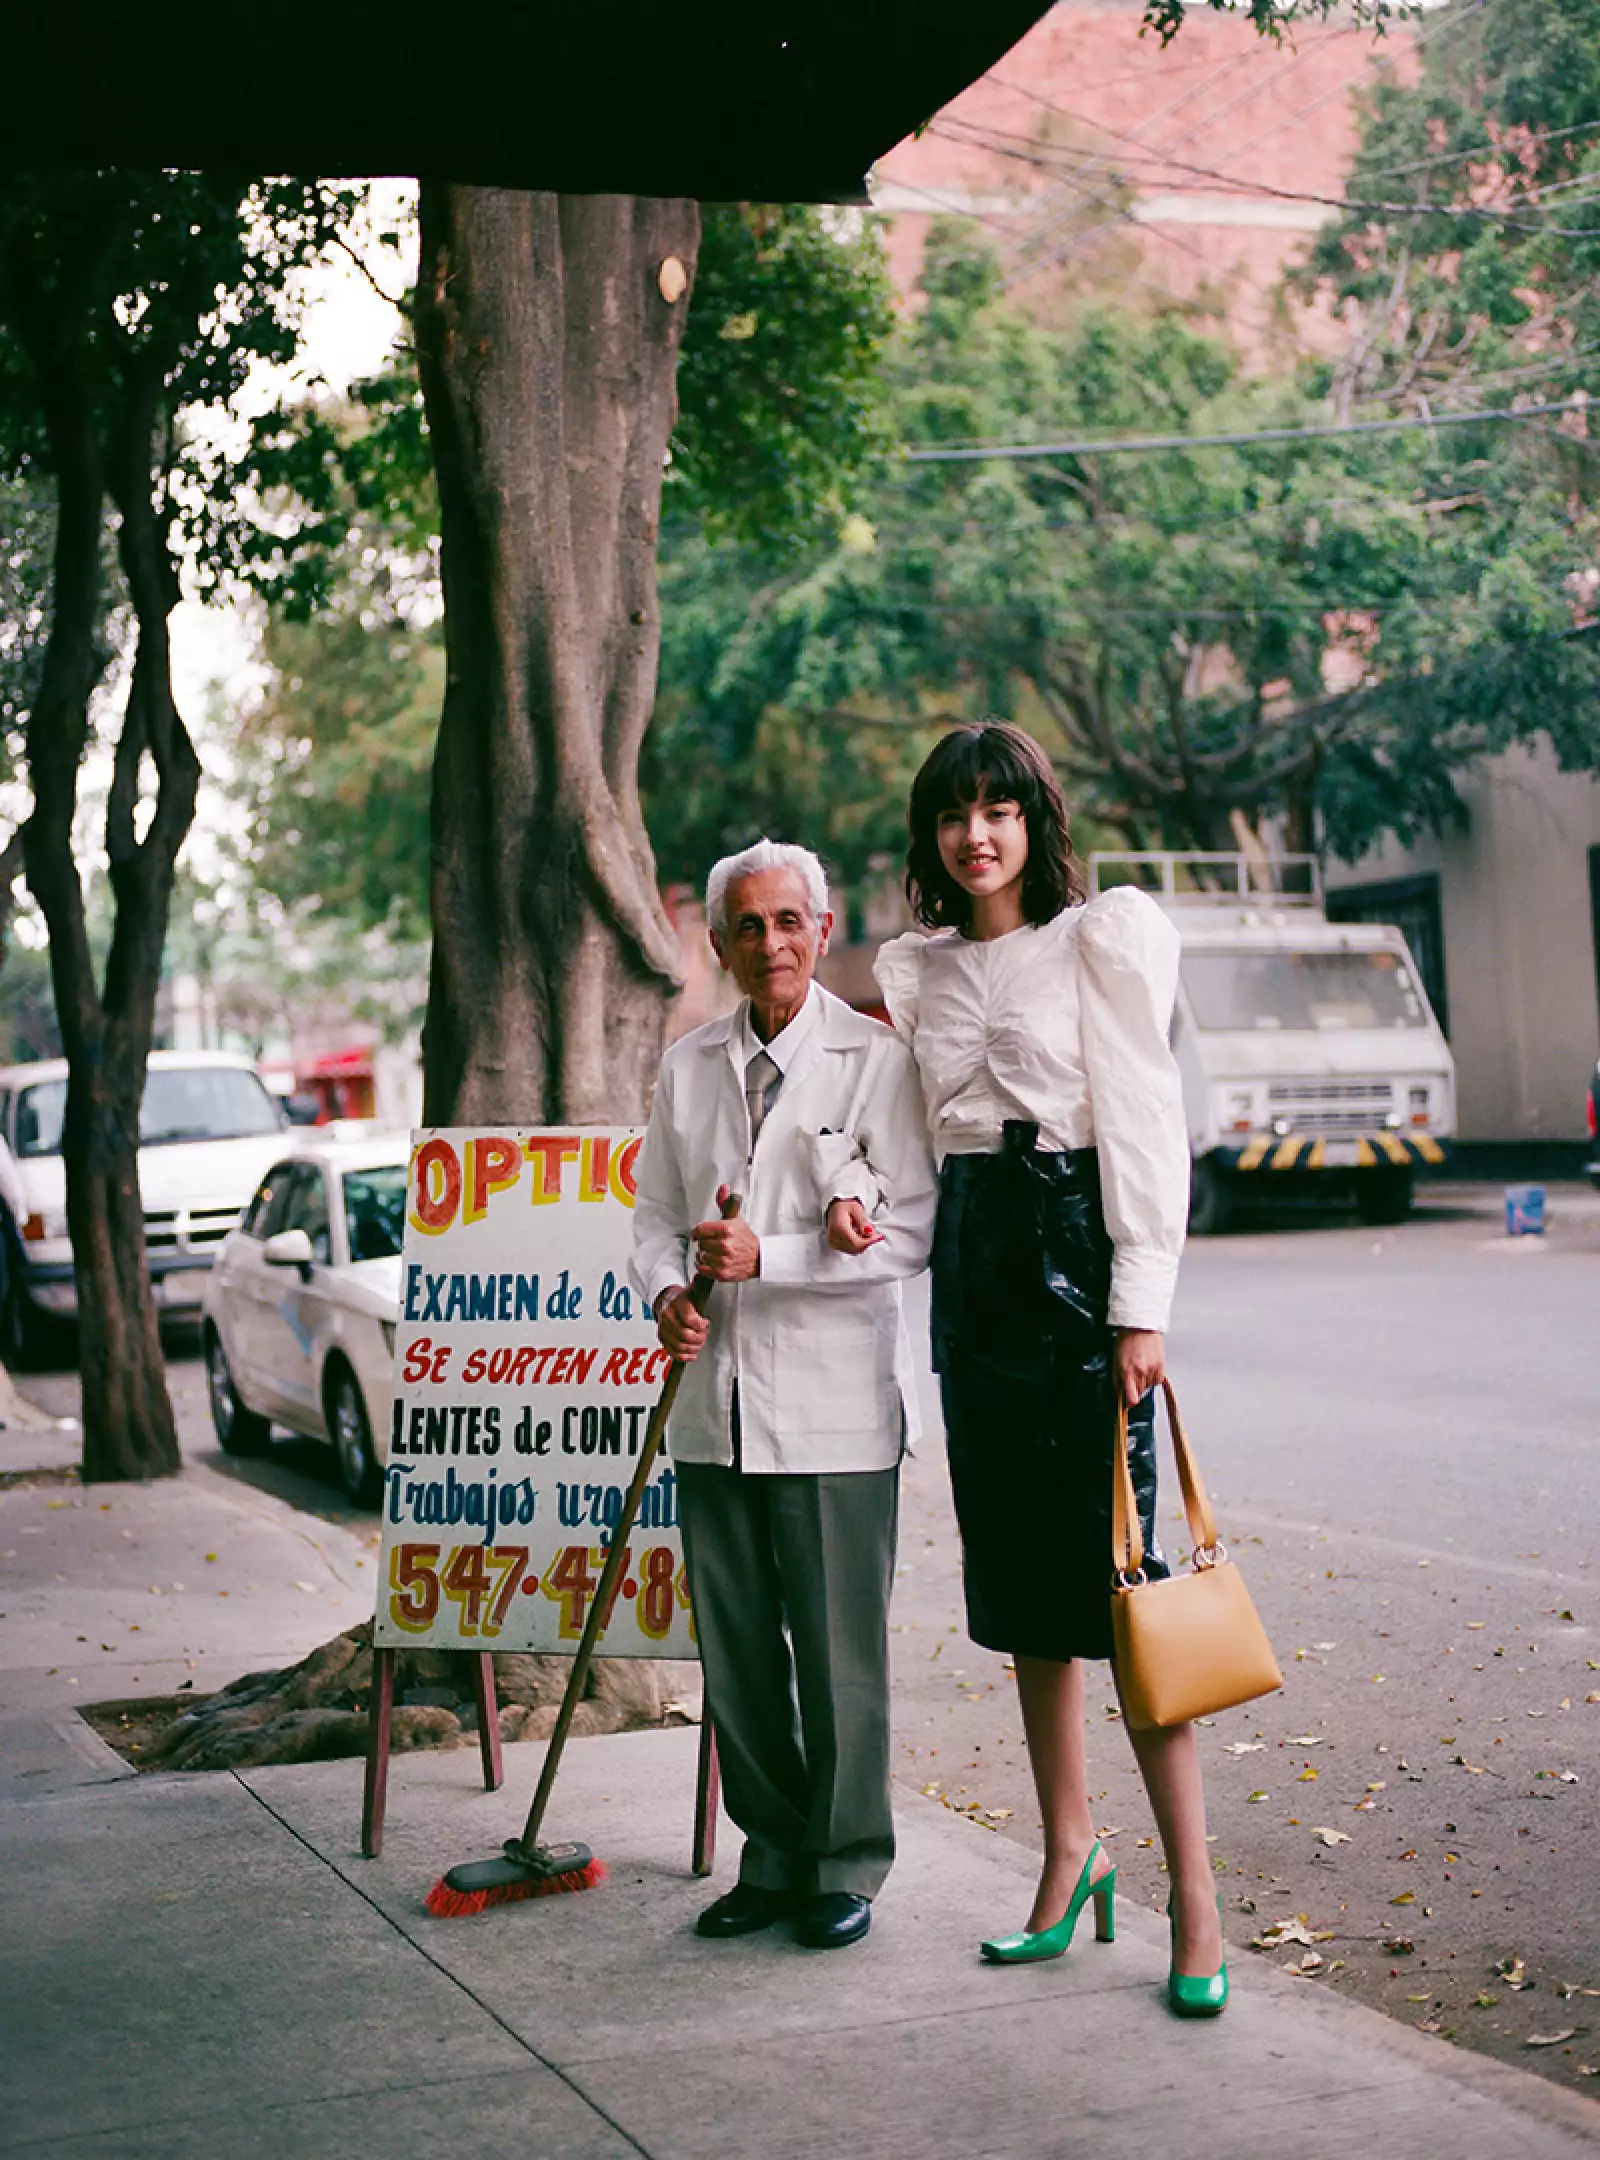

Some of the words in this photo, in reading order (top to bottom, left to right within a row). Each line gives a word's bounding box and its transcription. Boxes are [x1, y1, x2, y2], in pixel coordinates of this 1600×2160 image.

[404, 1264, 539, 1321] EXAMEN
[546, 1270, 583, 1321] de
[598, 1270, 633, 1322] la
[402, 1337, 452, 1384] SE
[462, 1347, 598, 1386] SURTEN
[391, 1398, 501, 1456] LENTES
[514, 1405, 552, 1456] de
[385, 1464, 538, 1546] Trabajos
[556, 1468, 680, 1546] urgnt
